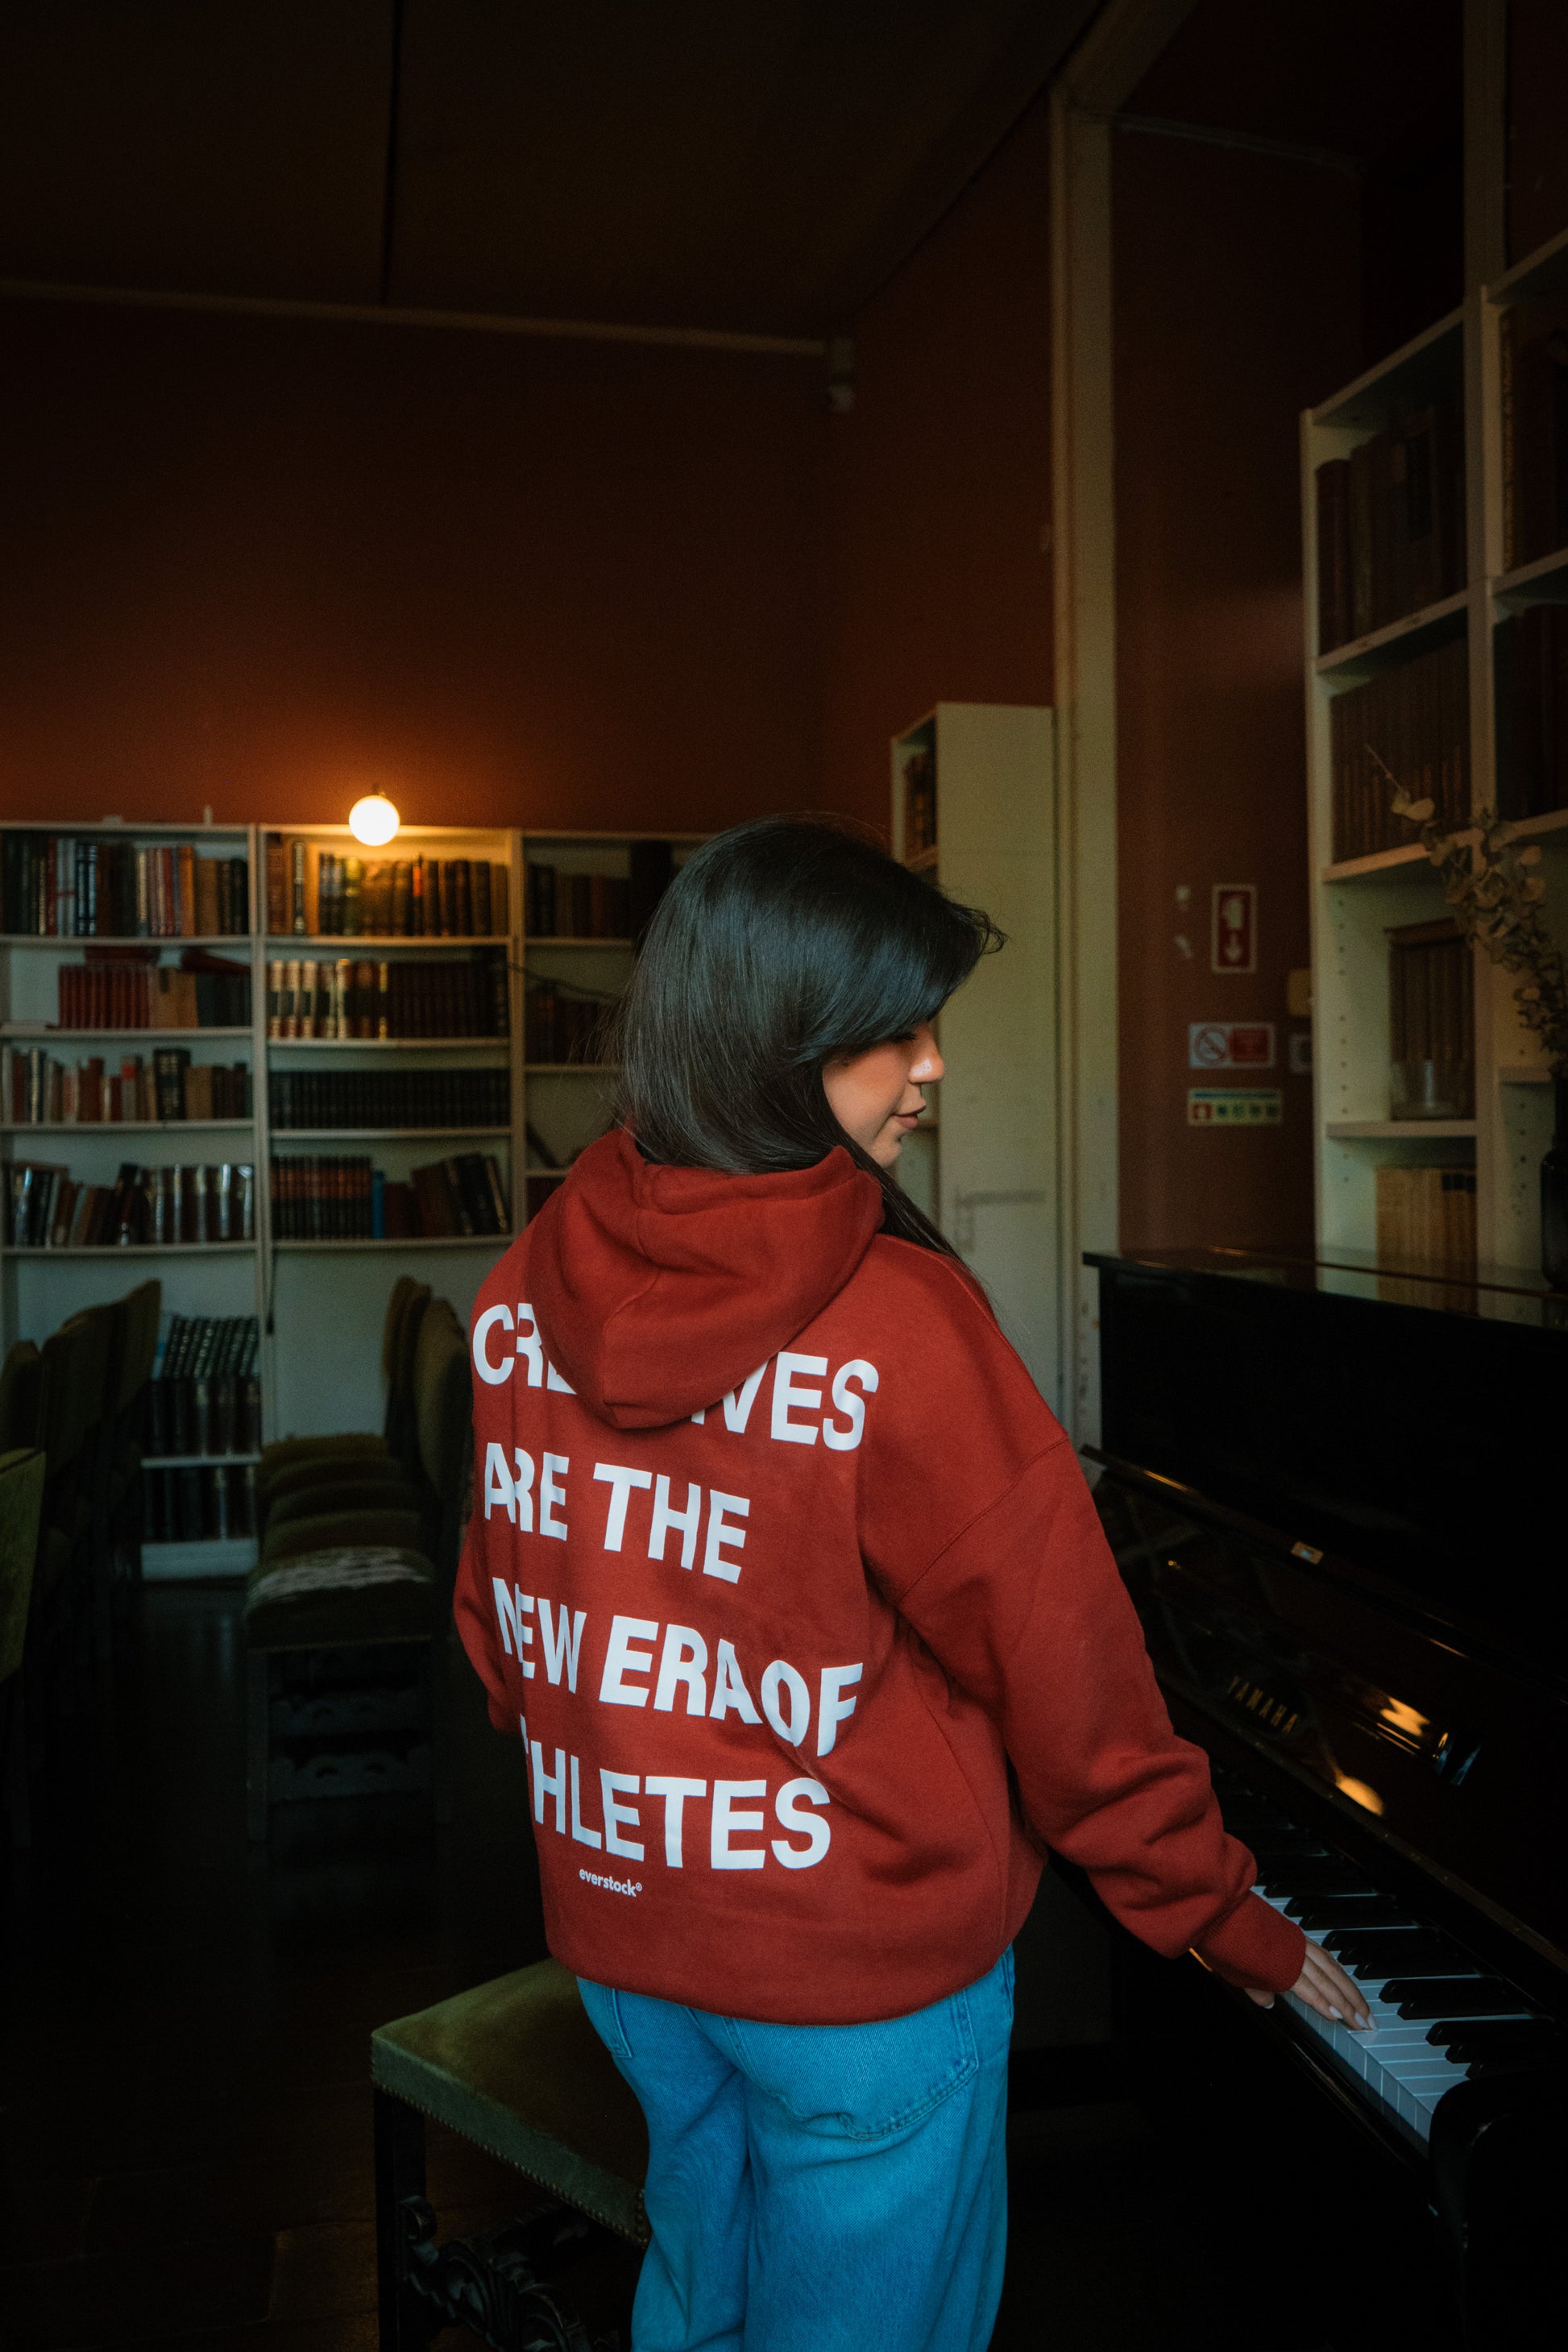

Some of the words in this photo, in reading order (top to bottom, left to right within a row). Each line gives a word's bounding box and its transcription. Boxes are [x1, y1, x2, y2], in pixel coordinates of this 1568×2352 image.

[472, 1302, 880, 1452] CRVES
[484, 1441, 569, 1541] ARE
[592, 1462, 751, 1585] THE
[492, 1577, 587, 1695] NEW
[598, 1615, 764, 1724] ERA
[760, 1659, 864, 1757] OF
[1226, 1675, 1299, 1734] YAMAHA
[520, 1714, 832, 1870] HLETES
